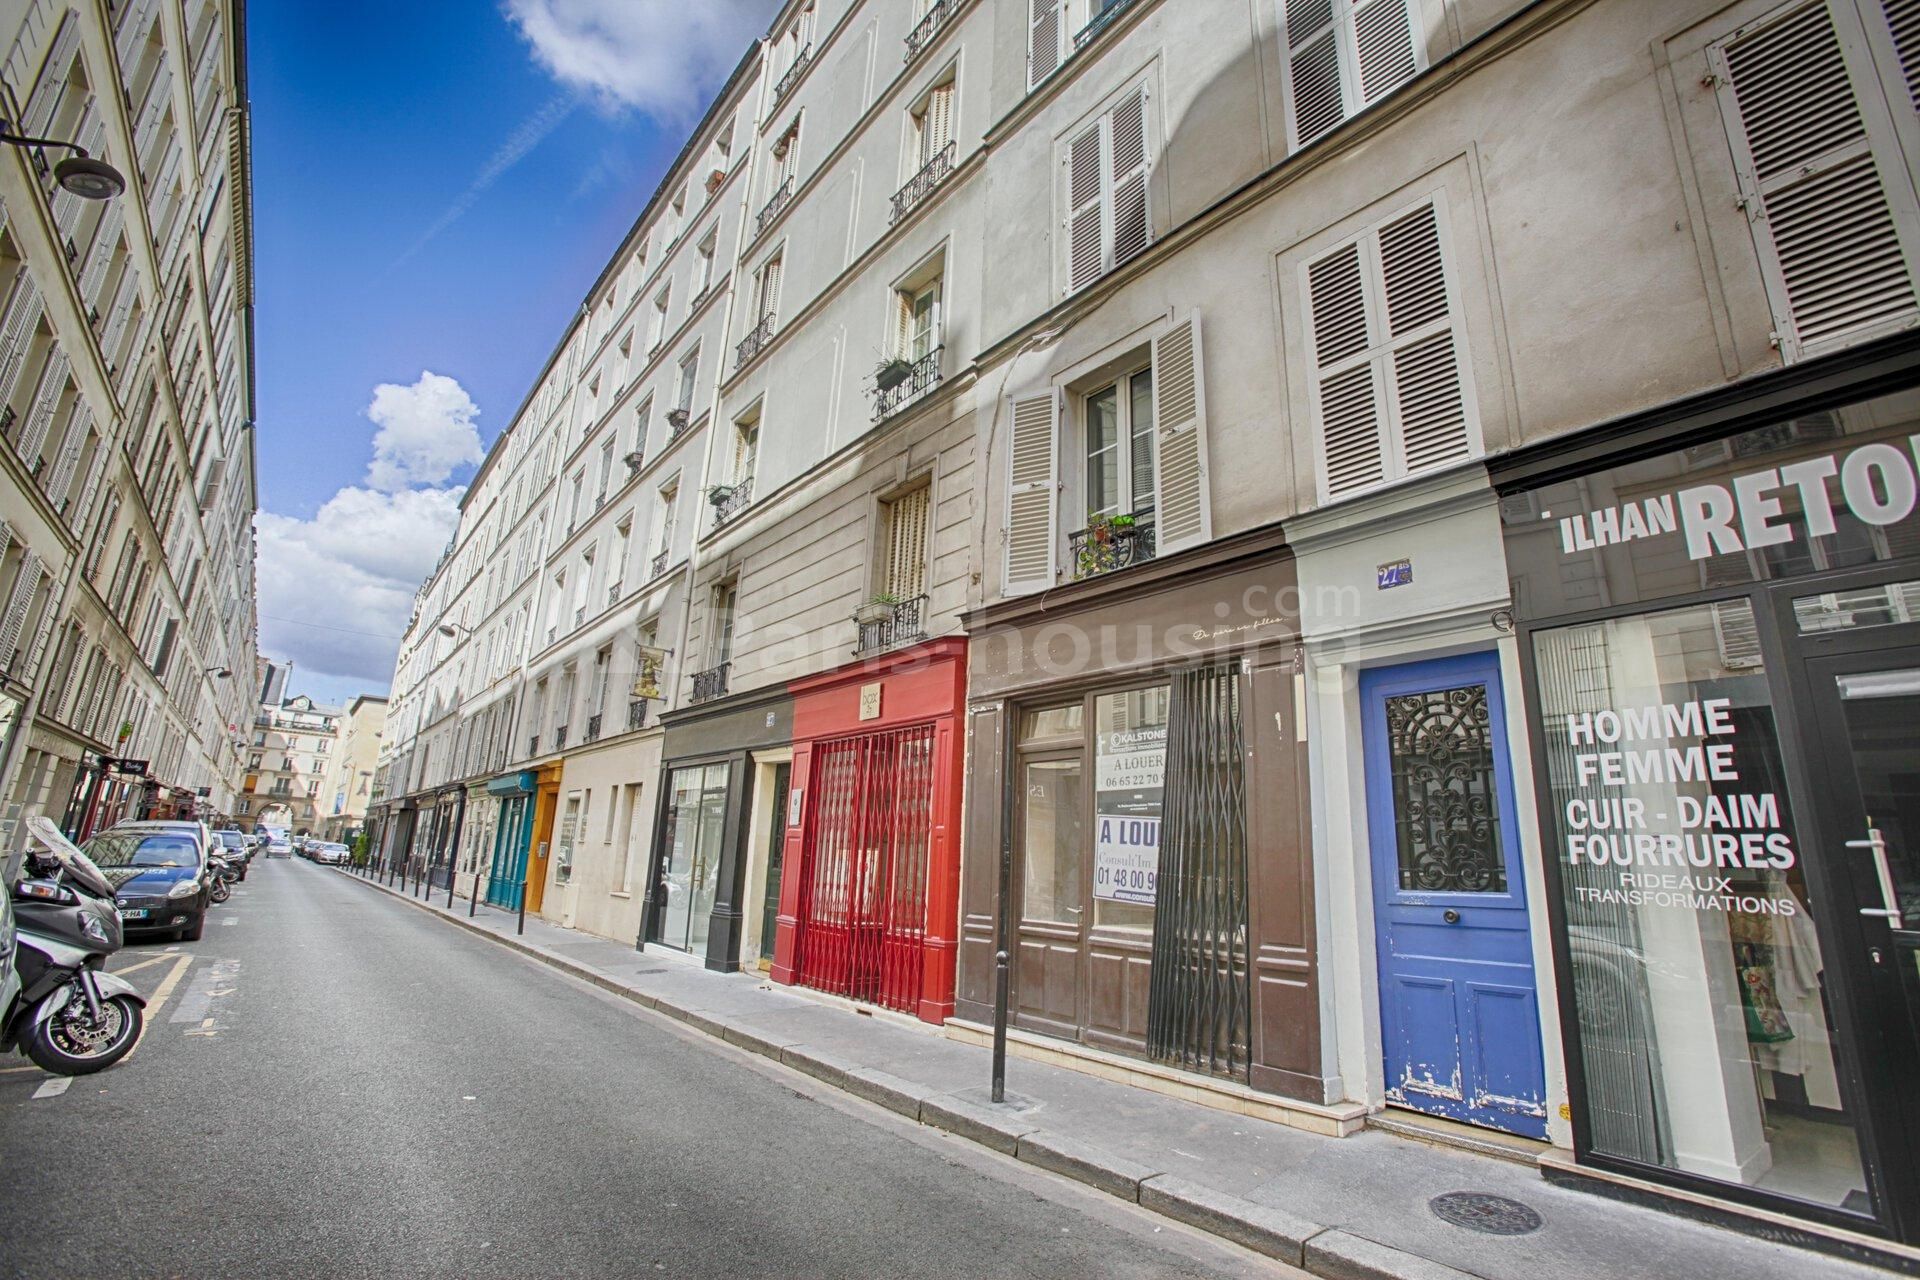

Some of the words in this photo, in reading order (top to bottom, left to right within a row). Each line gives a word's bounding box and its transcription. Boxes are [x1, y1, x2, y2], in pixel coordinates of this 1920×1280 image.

[1677, 434, 1920, 560] RETO
[1378, 564, 1398, 585] 27
[1192, 629, 1210, 640] De
[1568, 698, 1736, 746] HOMME
[1114, 760, 1121, 771] A
[1125, 755, 1163, 770] LOUER
[1576, 744, 1738, 786] FEMME
[1106, 778, 1117, 787] 06
[1120, 776, 1130, 786] 65
[1133, 775, 1144, 785] 22
[1147, 774, 1158, 784] 70
[1566, 798, 1647, 830] CUIR
[1677, 794, 1780, 829] DAIM
[1100, 820, 1111, 843] A
[1120, 821, 1161, 847] LOU
[1567, 833, 1796, 869] FOURRURES
[1098, 867, 1109, 884] 01
[1114, 869, 1127, 887] 48
[1131, 870, 1144, 889] 00
[1620, 873, 1734, 893] RIDEAUX
[1575, 887, 1796, 916] TRANSFORMATIONS
